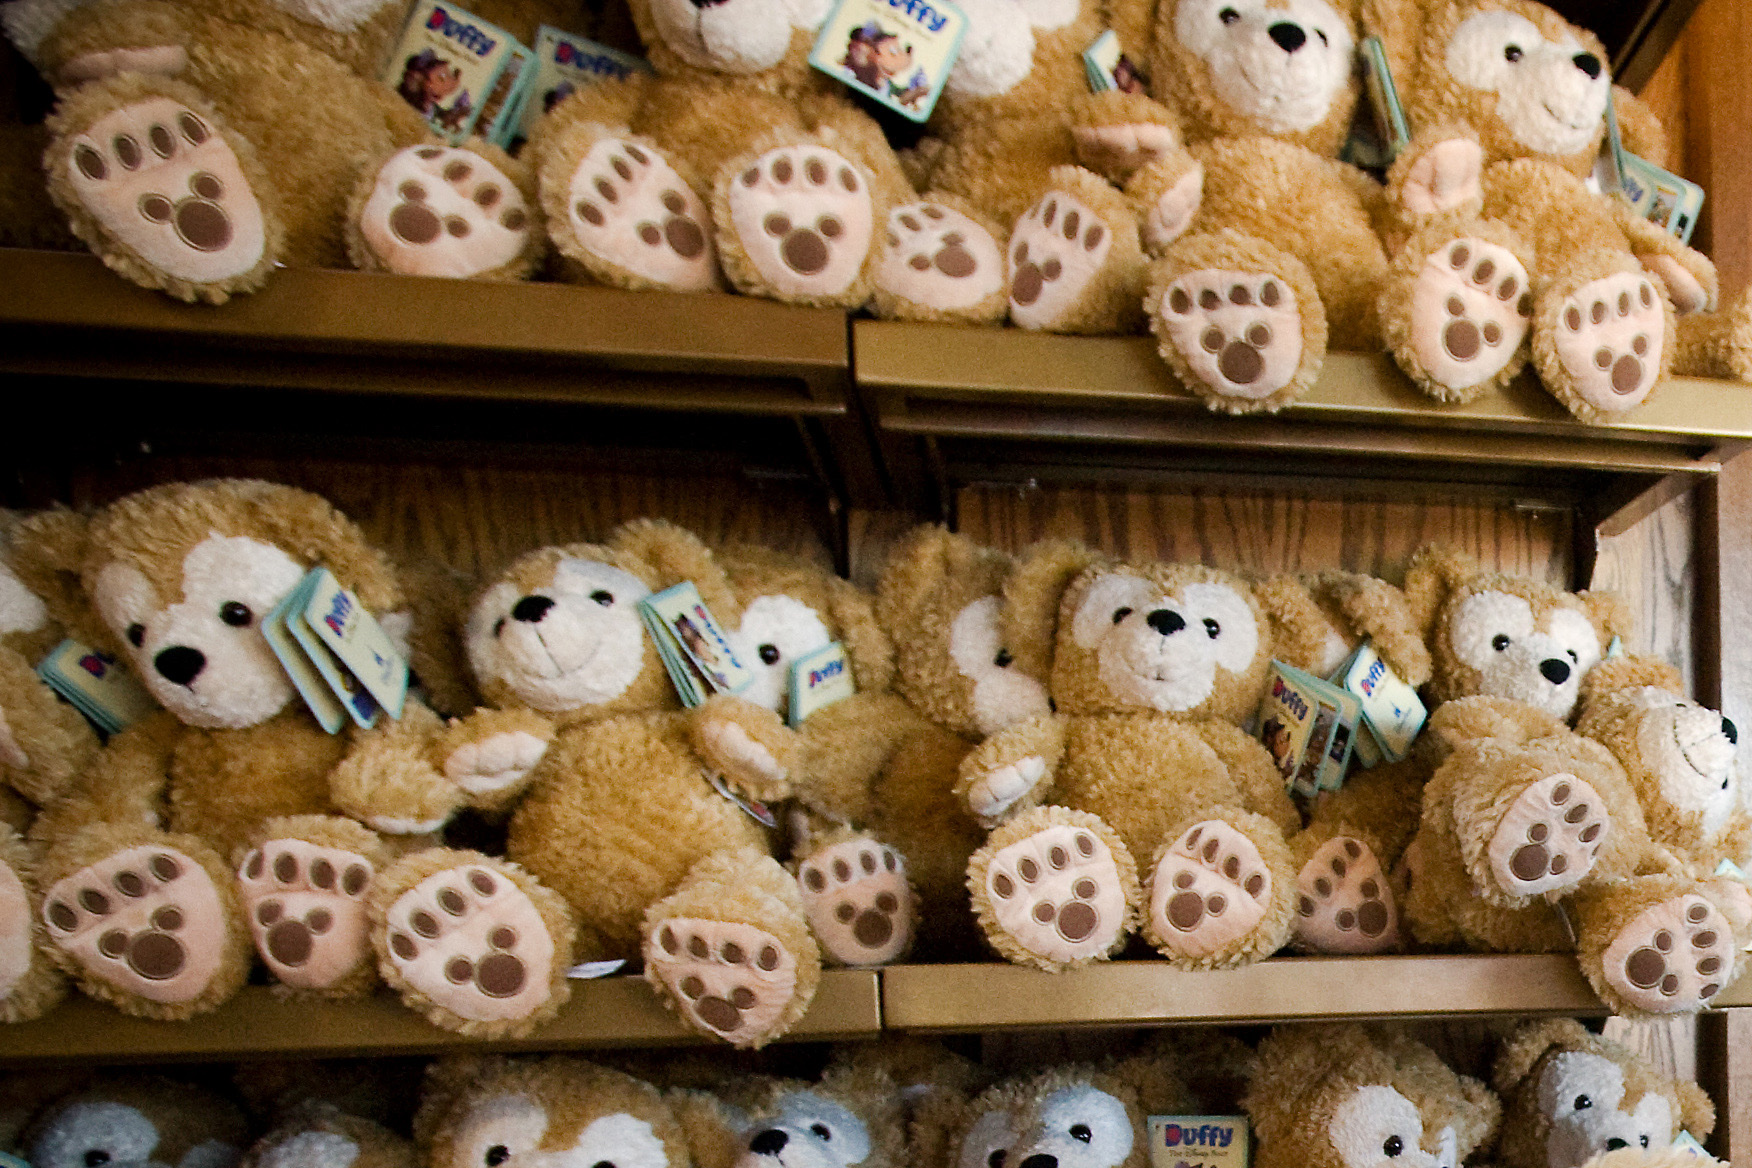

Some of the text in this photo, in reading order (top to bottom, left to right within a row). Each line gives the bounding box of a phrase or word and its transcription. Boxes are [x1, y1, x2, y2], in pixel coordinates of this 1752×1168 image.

[426, 6, 497, 57] Duffy
[1273, 676, 1309, 720] Duffy
[1165, 1124, 1234, 1147] Duffy
